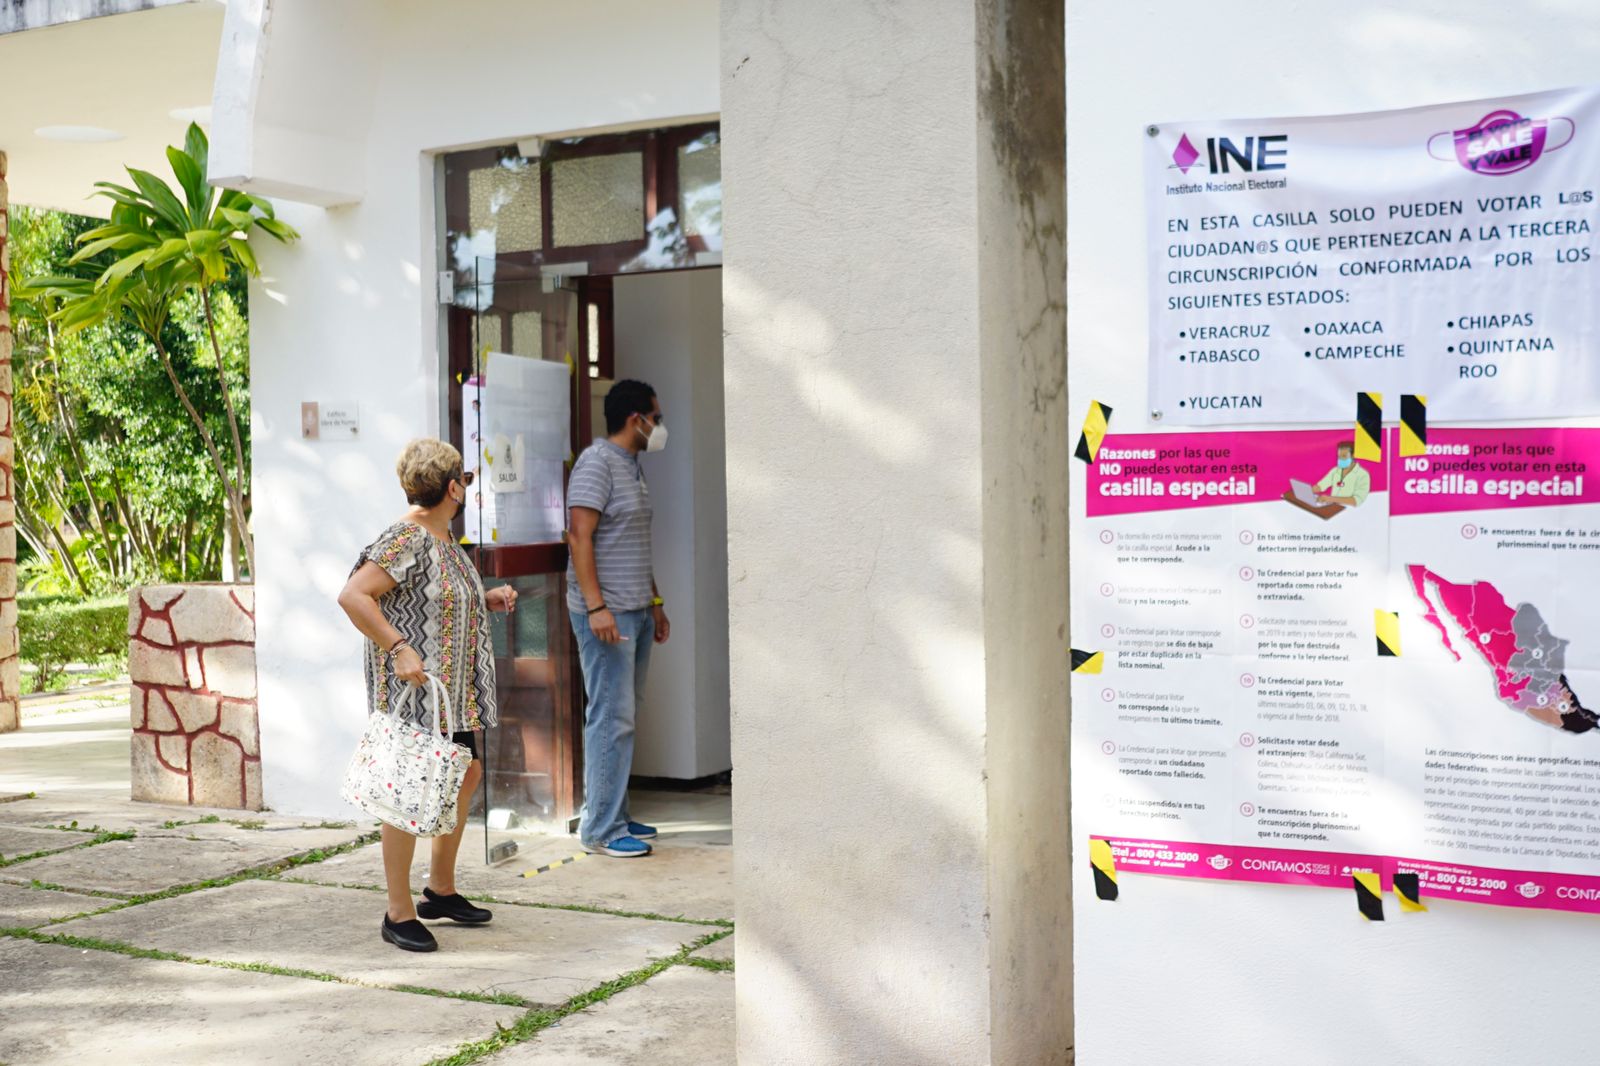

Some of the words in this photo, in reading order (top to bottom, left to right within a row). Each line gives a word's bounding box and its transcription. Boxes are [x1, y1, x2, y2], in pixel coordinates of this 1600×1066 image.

[1468, 127, 1532, 158] SALE
[1207, 135, 1287, 174] INE
[1469, 158, 1479, 170] Y
[1484, 143, 1531, 166] VALE
[1167, 184, 1202, 195] Instituto
[1206, 181, 1245, 192] Nacional
[1248, 178, 1287, 190] Electoral
[1168, 219, 1189, 233] EN
[1201, 216, 1239, 231] ESTA
[1253, 211, 1318, 228] CASILLA
[1330, 207, 1375, 224] SOLO
[1389, 201, 1463, 219] PUEDEN
[1478, 196, 1541, 213] VOTAR
[1559, 191, 1593, 207] L@S
[1168, 239, 1278, 259] CIUDADAN@S
[1285, 237, 1321, 253] QUE
[1328, 230, 1452, 250] PERTENEZCAN
[1459, 227, 1472, 242] A
[1479, 225, 1500, 241] LA
[1508, 220, 1590, 239] TERCERA
[1168, 261, 1318, 285] CIRCUNSCRIPCIÓN
[1339, 256, 1472, 276] CONFORMADA
[1495, 252, 1532, 267] POR
[1557, 248, 1590, 263] LOS
[1168, 292, 1261, 310] SIGUIENTES
[1267, 290, 1350, 306] ESTADOS:
[1315, 321, 1383, 336] OAXACA
[1458, 313, 1533, 330] CHIAPAS
[1189, 325, 1270, 339] VERACRUZ
[1315, 344, 1405, 359] CAMPECHE
[1458, 337, 1554, 355] QUINTANA
[1189, 349, 1260, 363] TABASCO
[1459, 364, 1497, 378] ROO
[1189, 396, 1262, 409] YUCATAN
[1100, 448, 1156, 459] Razones
[1159, 449, 1180, 461] por
[1184, 447, 1202, 458] las
[1206, 448, 1230, 461] que
[1425, 444, 1469, 455] zones
[1474, 444, 1500, 456] por
[1503, 443, 1522, 455] las
[1527, 445, 1555, 457] que
[1100, 464, 1121, 476] NO
[1124, 462, 1170, 476] puedes
[1174, 463, 1207, 474] votar
[1211, 464, 1227, 473] en
[1231, 462, 1258, 473] esta
[1405, 459, 1429, 471] NO
[1432, 460, 1485, 473] puedes
[1490, 461, 1527, 472] votar
[1533, 462, 1550, 472] en
[1555, 461, 1586, 472] esta
[499, 472, 517, 482] SALIDA
[1100, 479, 1164, 496] casilla
[1169, 477, 1255, 500] especial
[1405, 474, 1478, 494] casilla
[1484, 475, 1582, 500] especial
[1540, 528, 1561, 536] fuera
[1565, 528, 1574, 536] de
[1579, 529, 1586, 537] la
[1498, 540, 1549, 548] plurinominal
[1268, 677, 1304, 685] Credencial
[1128, 704, 1169, 712] corresponde
[1258, 737, 1294, 745] Solicitaste
[1169, 760, 1205, 768] ciudadano
[1268, 807, 1307, 816] encuentras
[1136, 849, 1154, 858] 800
[1156, 851, 1173, 860] 433
[1175, 852, 1198, 862] 2000
[1242, 859, 1312, 874] CONTAMOS
[1437, 873, 1456, 883] 800
[1459, 876, 1477, 886] 433
[1480, 879, 1507, 889] 2000
